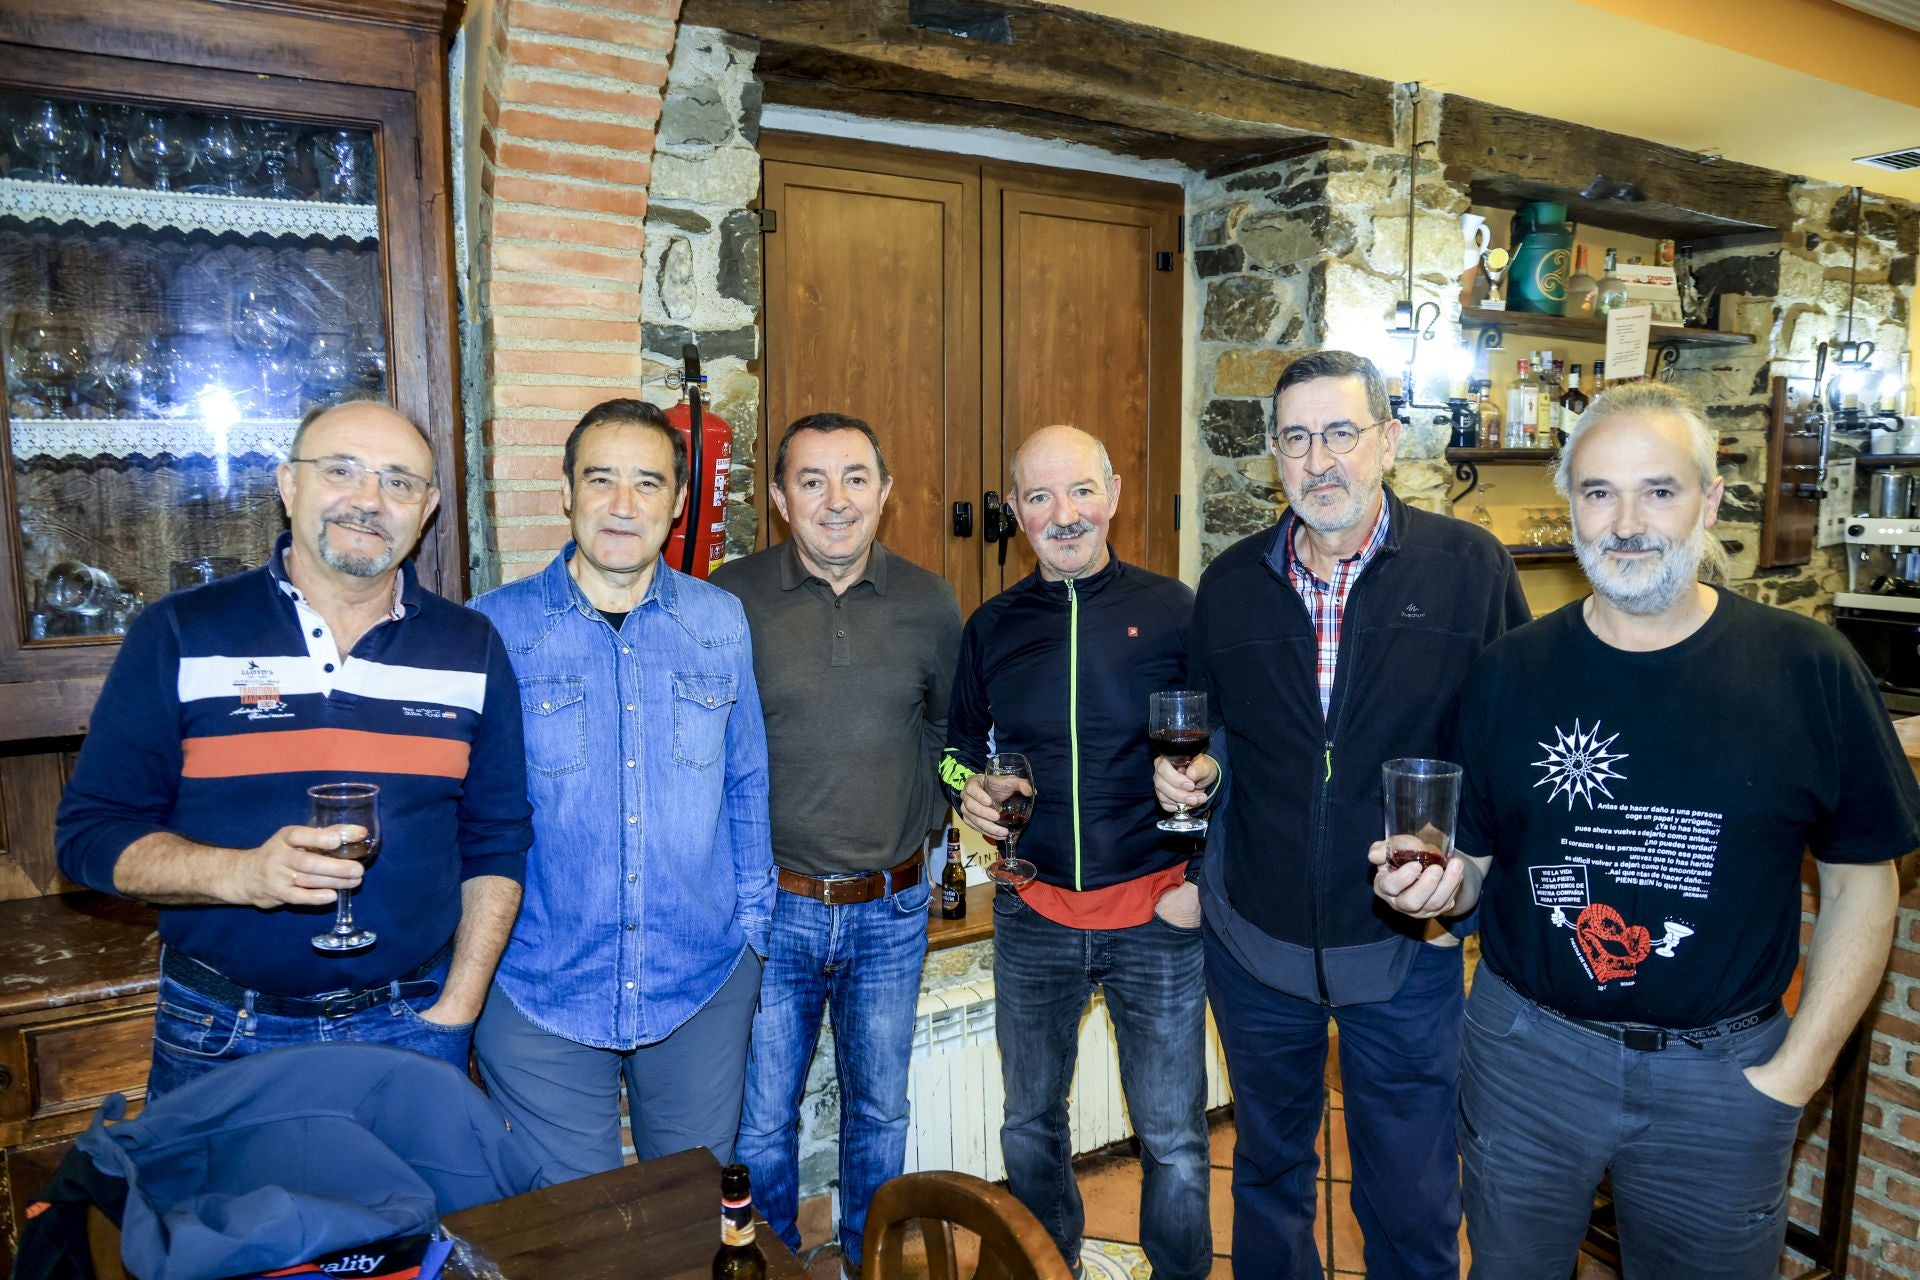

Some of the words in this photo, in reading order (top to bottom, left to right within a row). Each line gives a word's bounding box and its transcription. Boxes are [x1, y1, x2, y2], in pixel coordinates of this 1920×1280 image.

[1625, 813, 1643, 821] coge
[1653, 815, 1674, 823] papel
[1691, 810, 1723, 820] persona
[1574, 825, 1592, 833] pues
[1592, 826, 1613, 834] ahora
[1613, 828, 1637, 836] vuelve
[1641, 830, 1666, 838] dejarlo
[1667, 833, 1688, 841] como
[1655, 822, 1669, 831] ¿Ya
[1677, 825, 1691, 833] has
[1692, 826, 1721, 836] hecho?
[1595, 842, 1604, 850] de
[1605, 843, 1616, 851] las
[1656, 848, 1677, 856] como
[1692, 853, 1715, 862] papel,
[1658, 840, 1686, 849] puedes
[1686, 843, 1718, 853] verdad?
[1591, 858, 1613, 866] volver
[1668, 866, 1712, 877] encontraste
[1675, 858, 1689, 866] has
[1689, 860, 1714, 868] herido
[1621, 869, 1636, 877] que
[1661, 872, 1683, 882] hacer
[1638, 878, 1655, 886] BIEN
[1655, 879, 1663, 887] lo
[1663, 882, 1678, 890] que
[1729, 1015, 1759, 1031] OOD
[320, 1255, 385, 1274] ality
